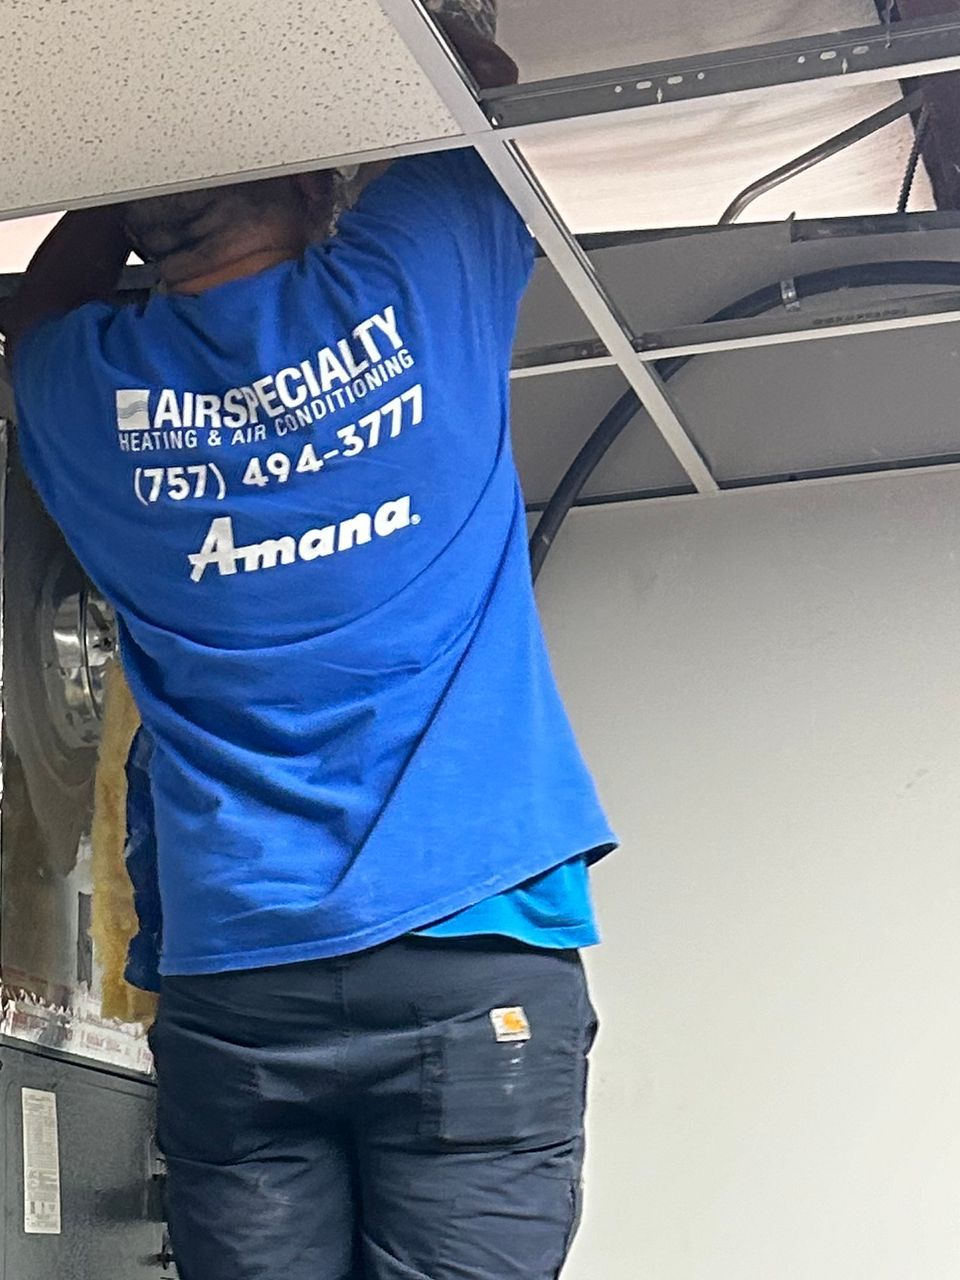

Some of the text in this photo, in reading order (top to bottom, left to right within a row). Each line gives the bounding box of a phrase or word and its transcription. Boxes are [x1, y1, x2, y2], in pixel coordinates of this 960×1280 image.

[119, 348, 415, 452] HEATING & AIR CONDITIONING
[153, 305, 404, 429] AIRSPECIALTY
[134, 384, 424, 506] (757) 494-3777
